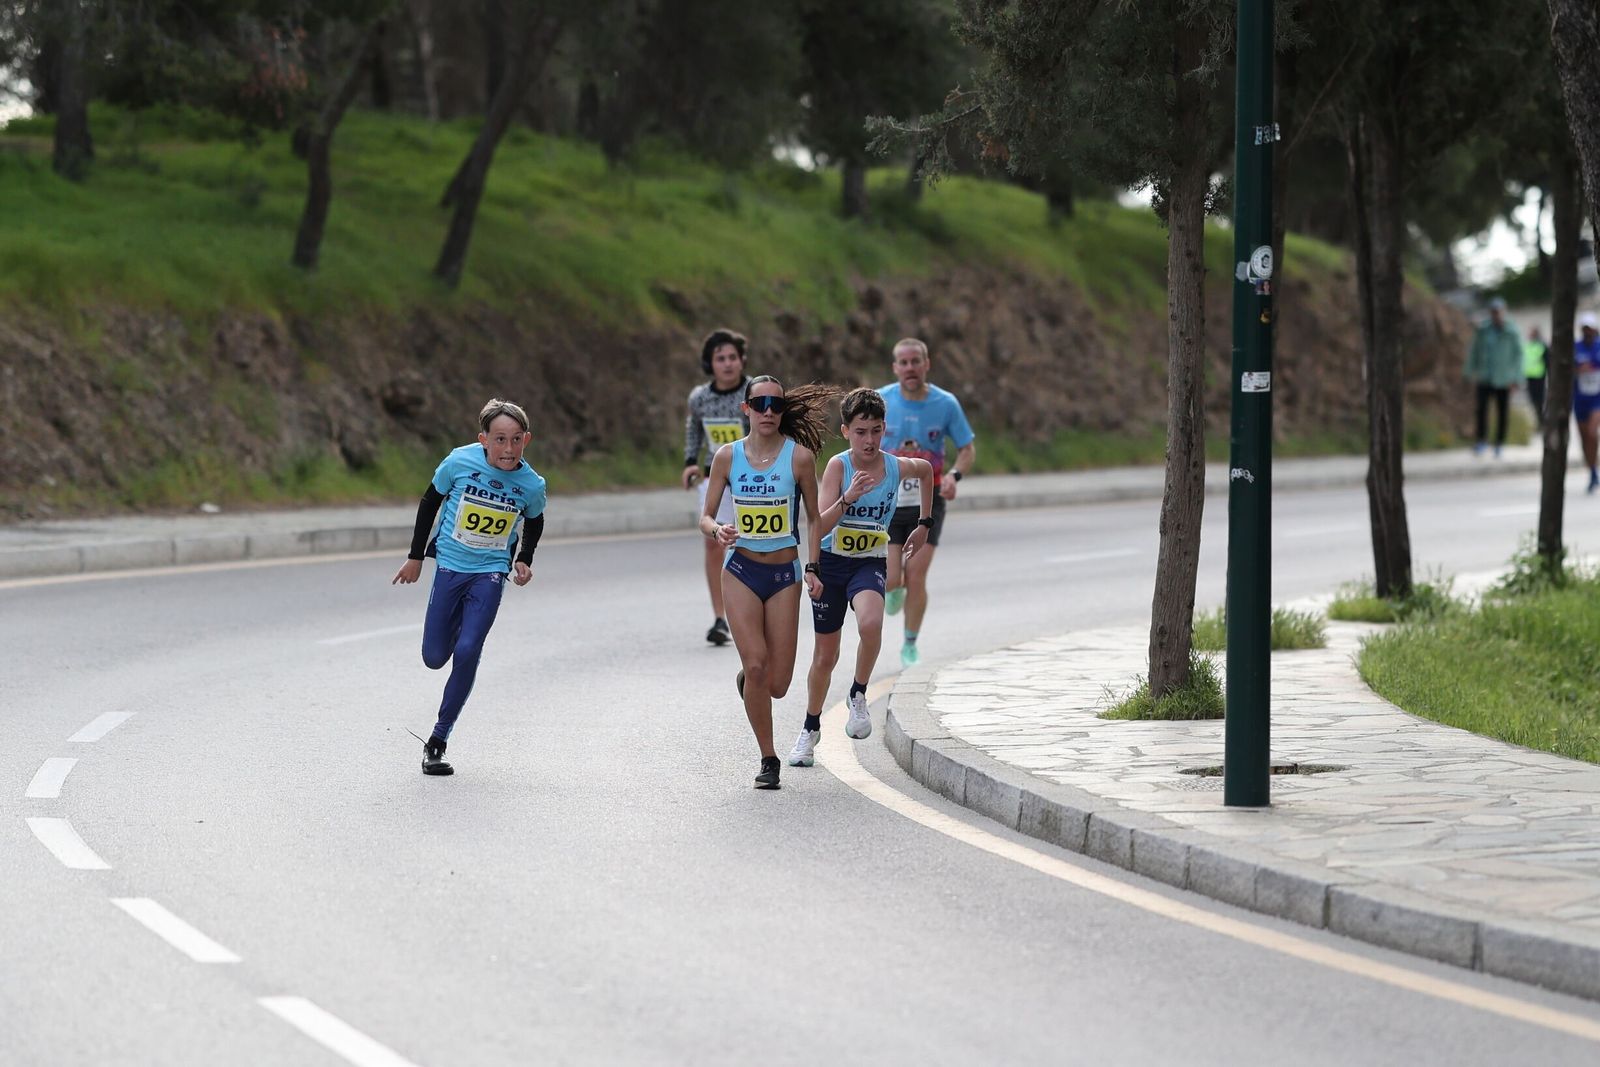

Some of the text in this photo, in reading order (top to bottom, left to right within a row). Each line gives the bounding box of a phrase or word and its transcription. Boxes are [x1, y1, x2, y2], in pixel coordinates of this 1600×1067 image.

[711, 430, 737, 443] 911
[741, 483, 775, 494] nerja
[465, 512, 507, 535] 929
[742, 514, 783, 533] 920
[842, 534, 879, 551] 907
